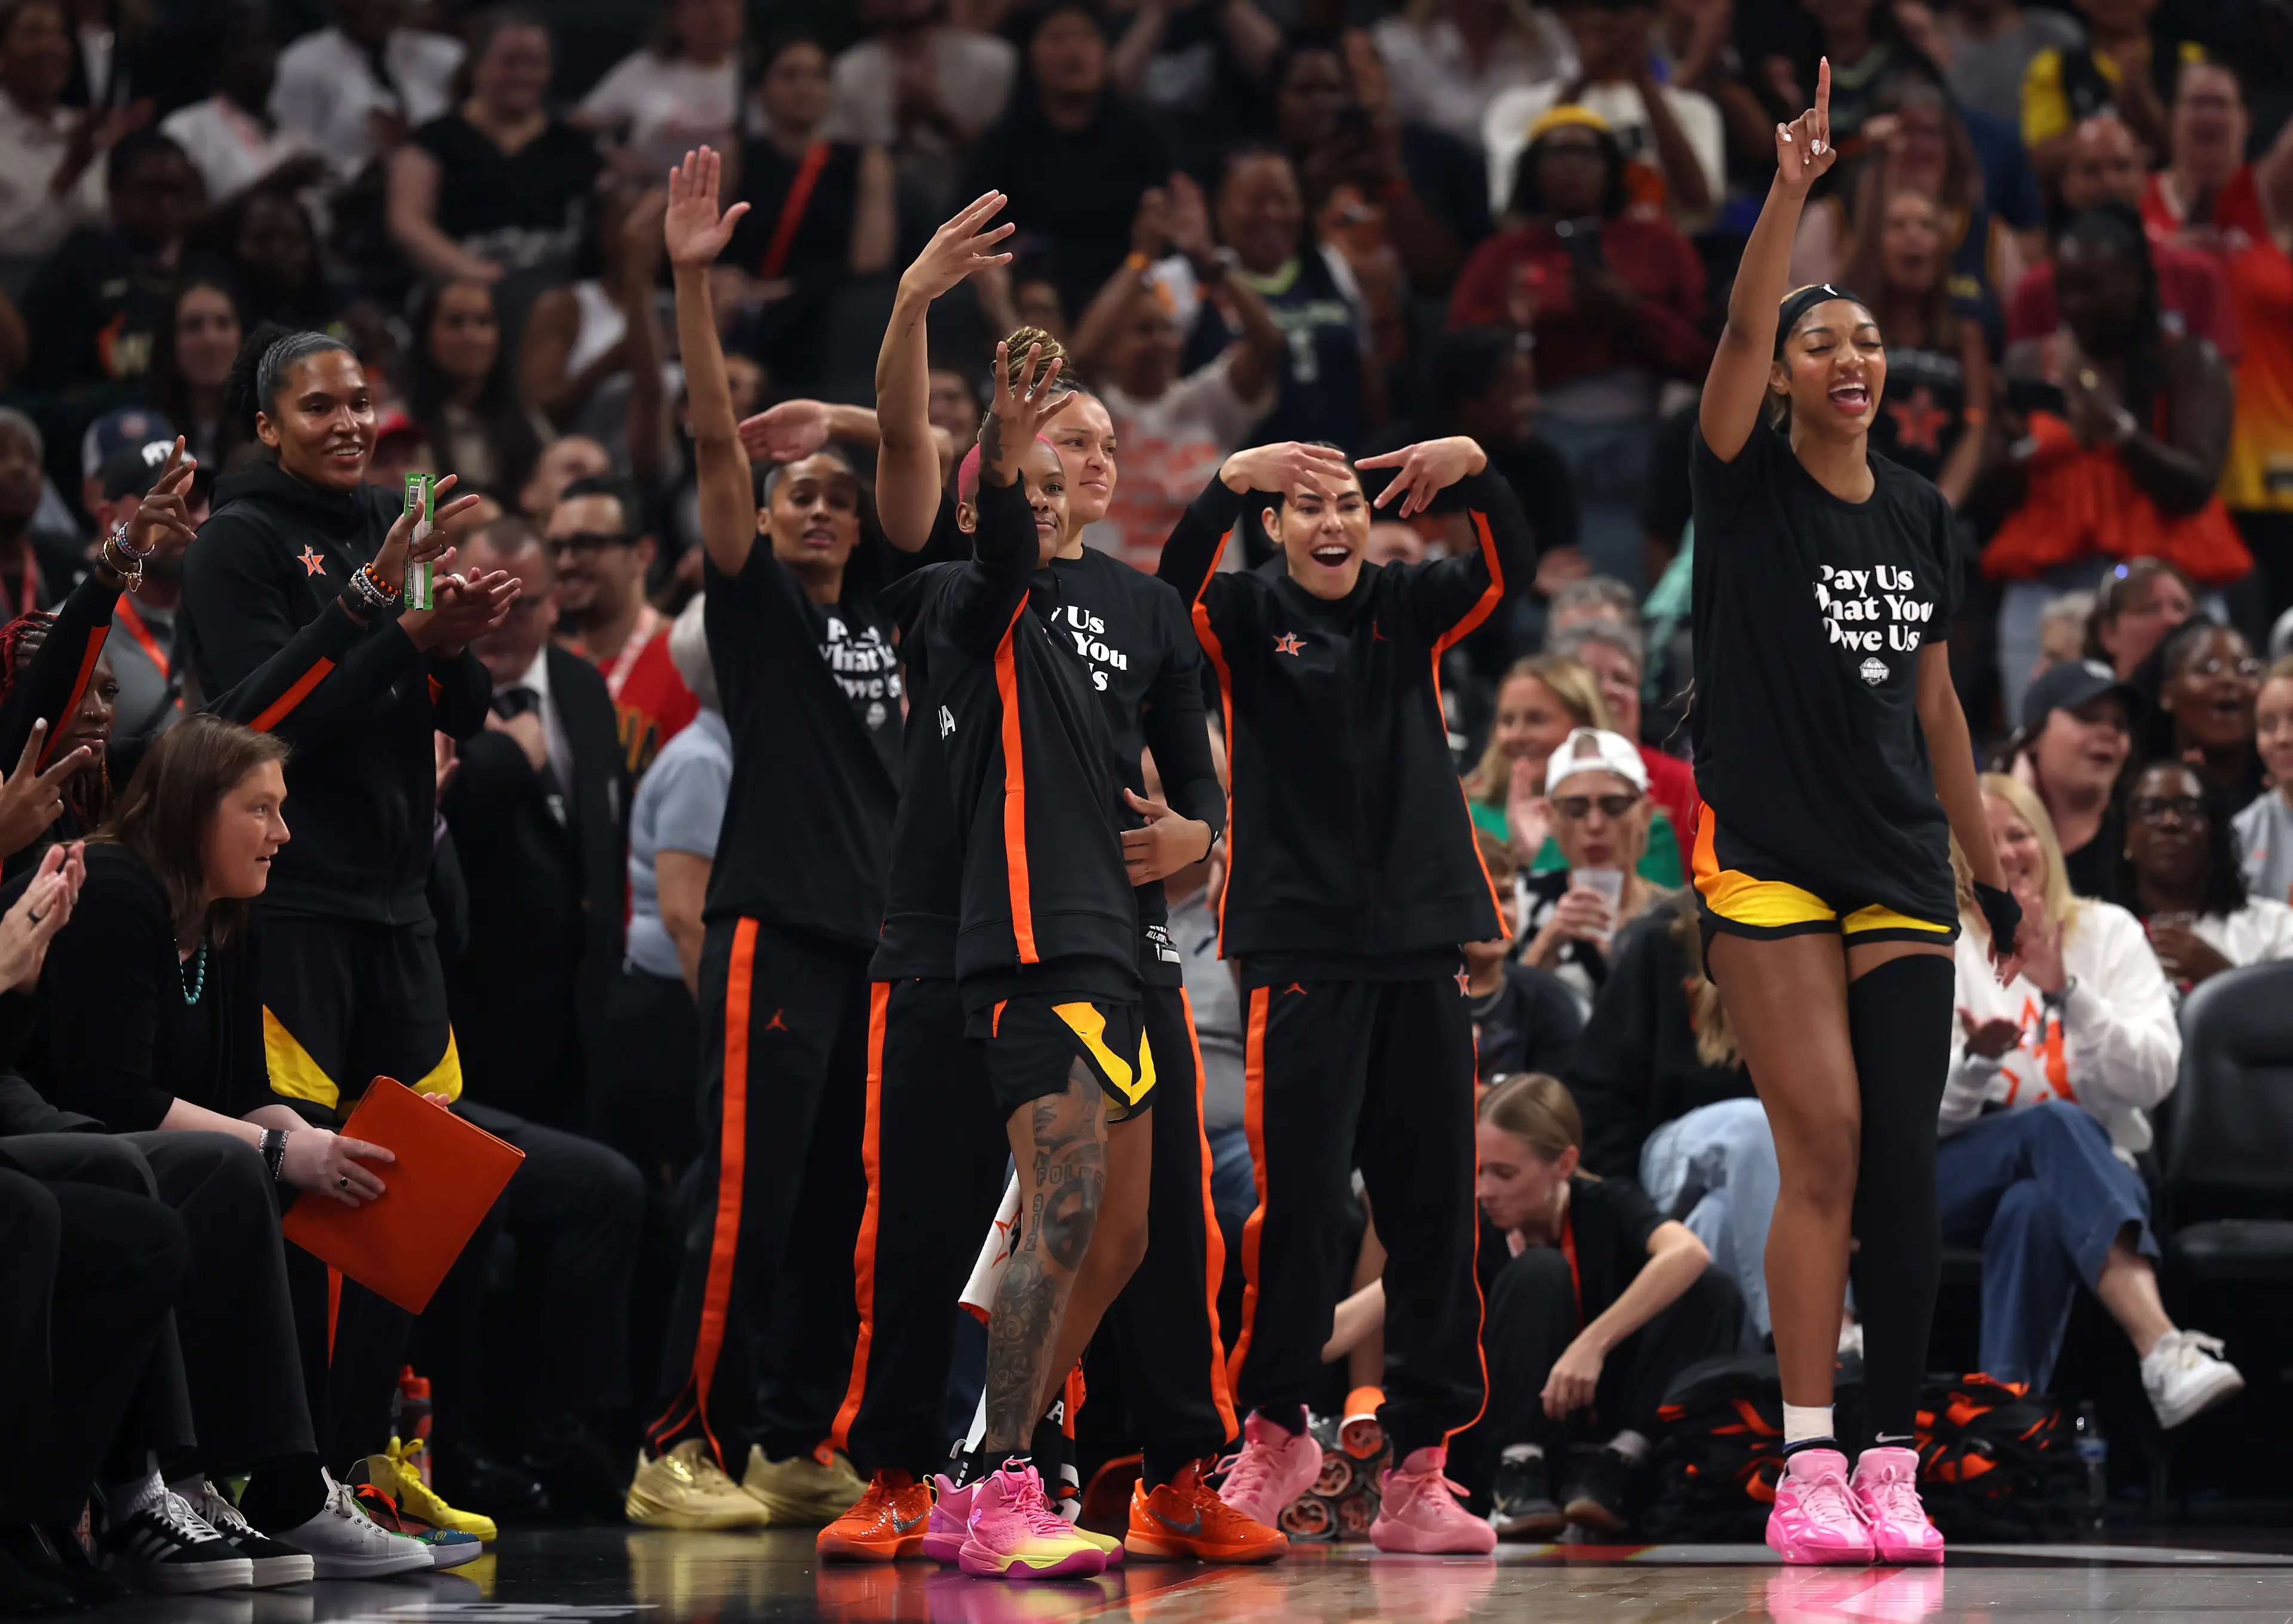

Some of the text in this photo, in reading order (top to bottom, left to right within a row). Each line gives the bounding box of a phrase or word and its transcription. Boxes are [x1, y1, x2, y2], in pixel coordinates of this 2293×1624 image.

[1874, 565, 1914, 590] Us
[1067, 605, 1105, 635] Us
[1883, 594, 1934, 623] You
[1071, 630, 1127, 671] You
[1888, 625, 1921, 652] Us
